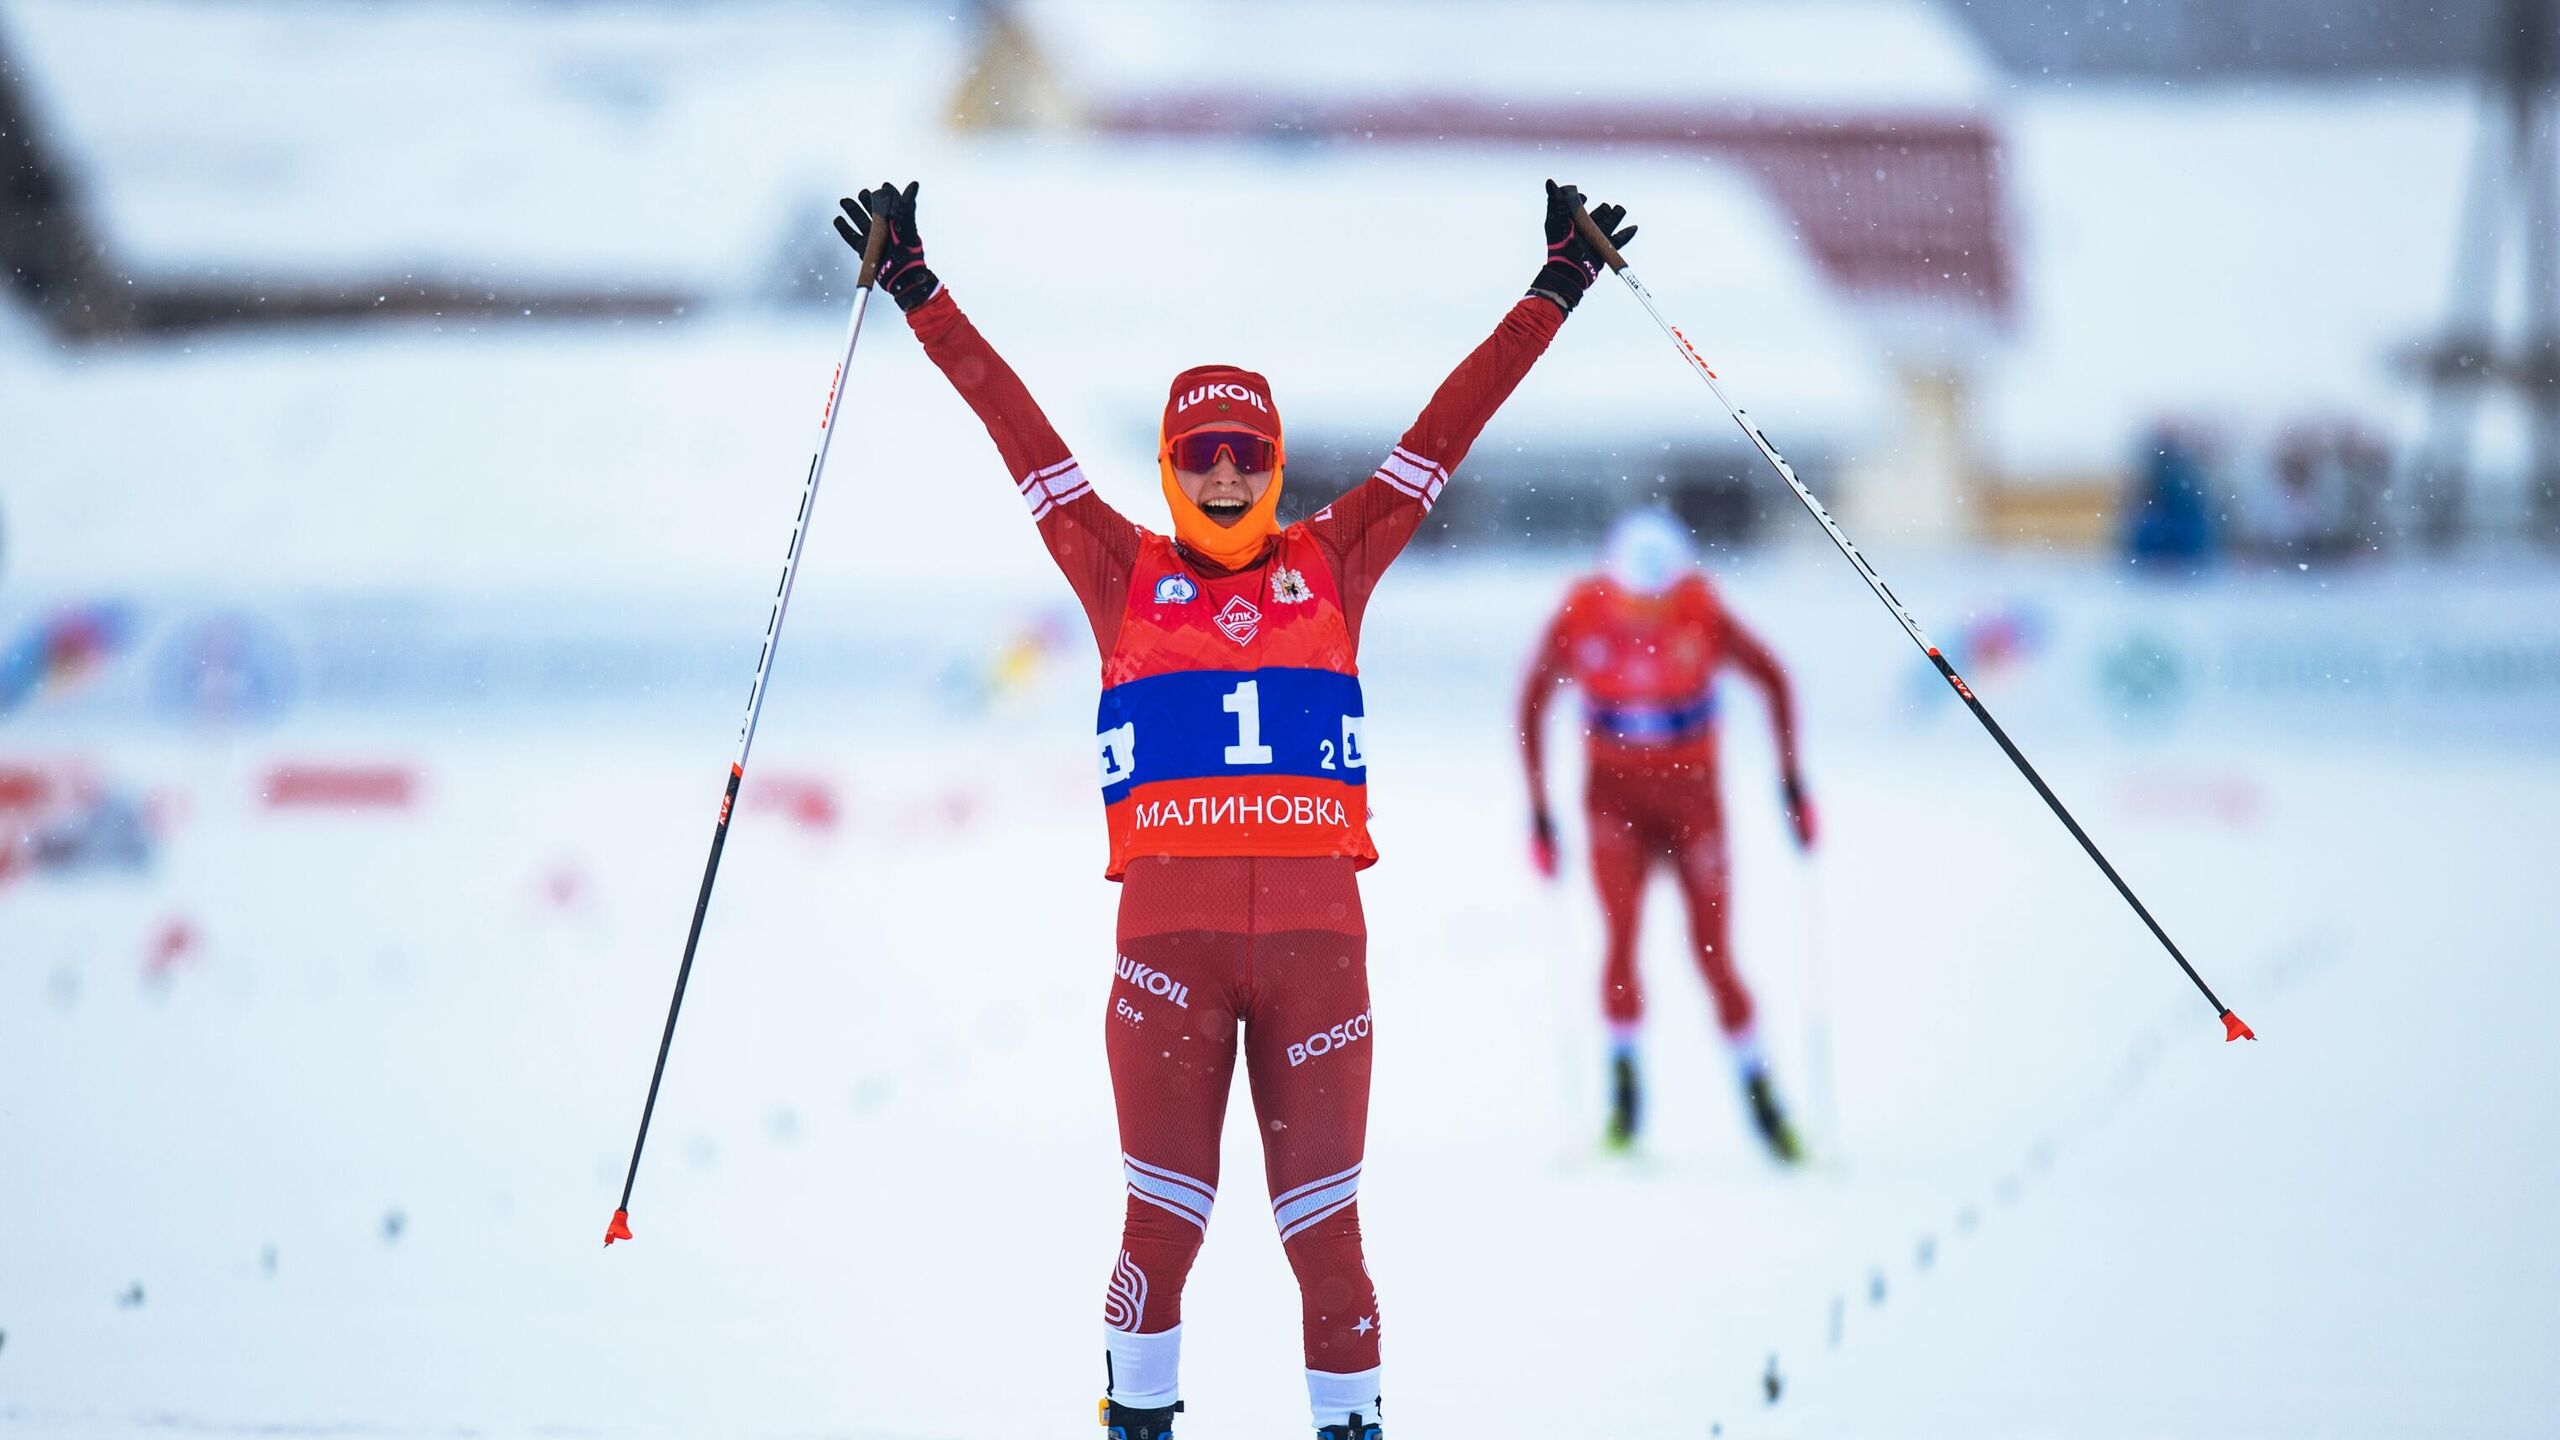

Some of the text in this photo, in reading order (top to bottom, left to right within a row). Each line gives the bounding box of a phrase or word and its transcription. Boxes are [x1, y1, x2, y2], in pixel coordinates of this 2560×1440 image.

[1177, 383, 1268, 414] LUKOIL
[1227, 612, 1252, 622] УЛК
[1222, 680, 1273, 764] 1
[1102, 744, 1121, 774] 1
[1319, 739, 1336, 770] 2
[1347, 732, 1362, 761] 1
[1135, 795, 1350, 830] МАЛИНОВКА
[1286, 1006, 1371, 1068] BOSCO
